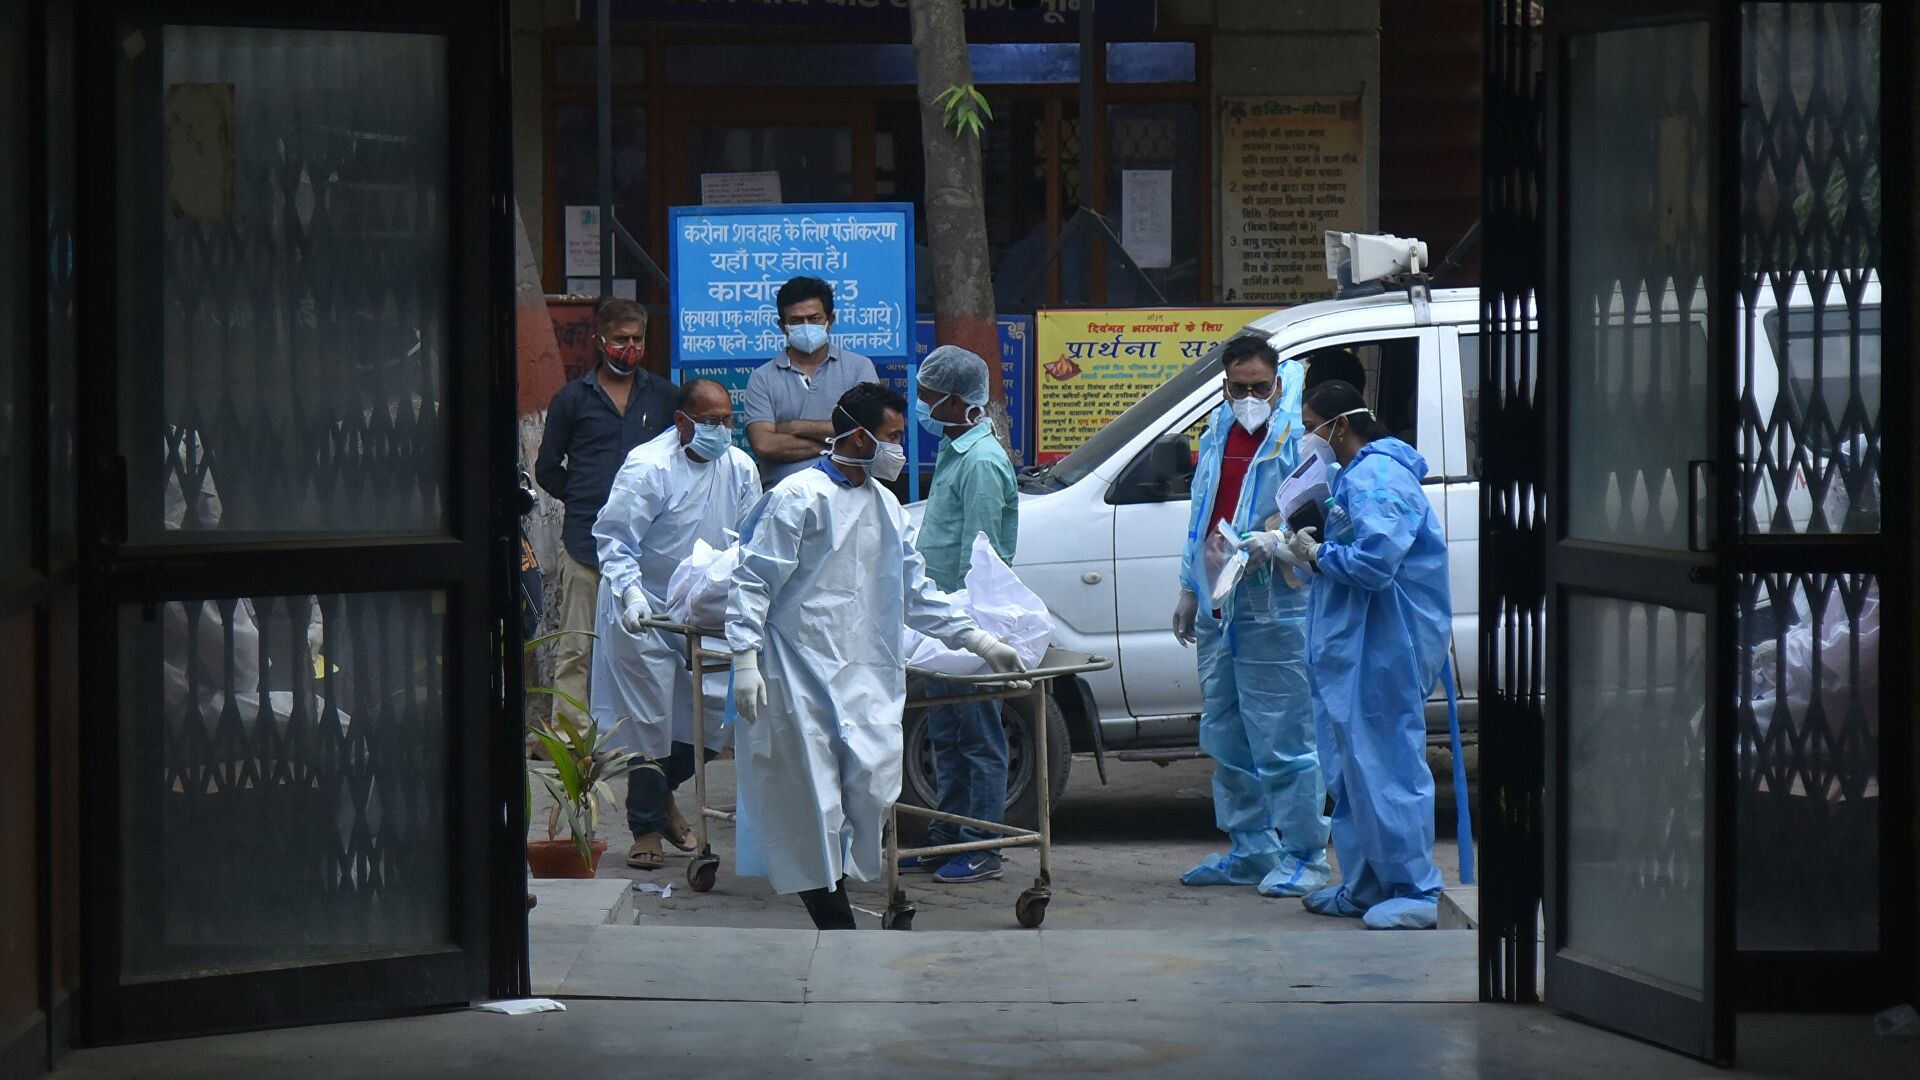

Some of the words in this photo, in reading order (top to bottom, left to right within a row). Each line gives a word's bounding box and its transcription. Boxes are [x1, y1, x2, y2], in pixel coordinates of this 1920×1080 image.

[684, 219, 729, 245] करोना
[783, 217, 800, 241] के
[801, 217, 830, 245] लिए
[830, 216, 898, 243] पंजीकरण
[752, 252, 782, 273] पर
[781, 247, 825, 273] होता
[721, 310, 743, 330] एक
[843, 303, 857, 325] में
[1088, 321, 1125, 333] दिवंगत
[1132, 321, 1179, 333] आत्माओं
[1185, 320, 1196, 333] के
[1201, 321, 1225, 333] लिए
[682, 335, 716, 353] मास्क
[1065, 334, 1162, 359] प्रार्थना
